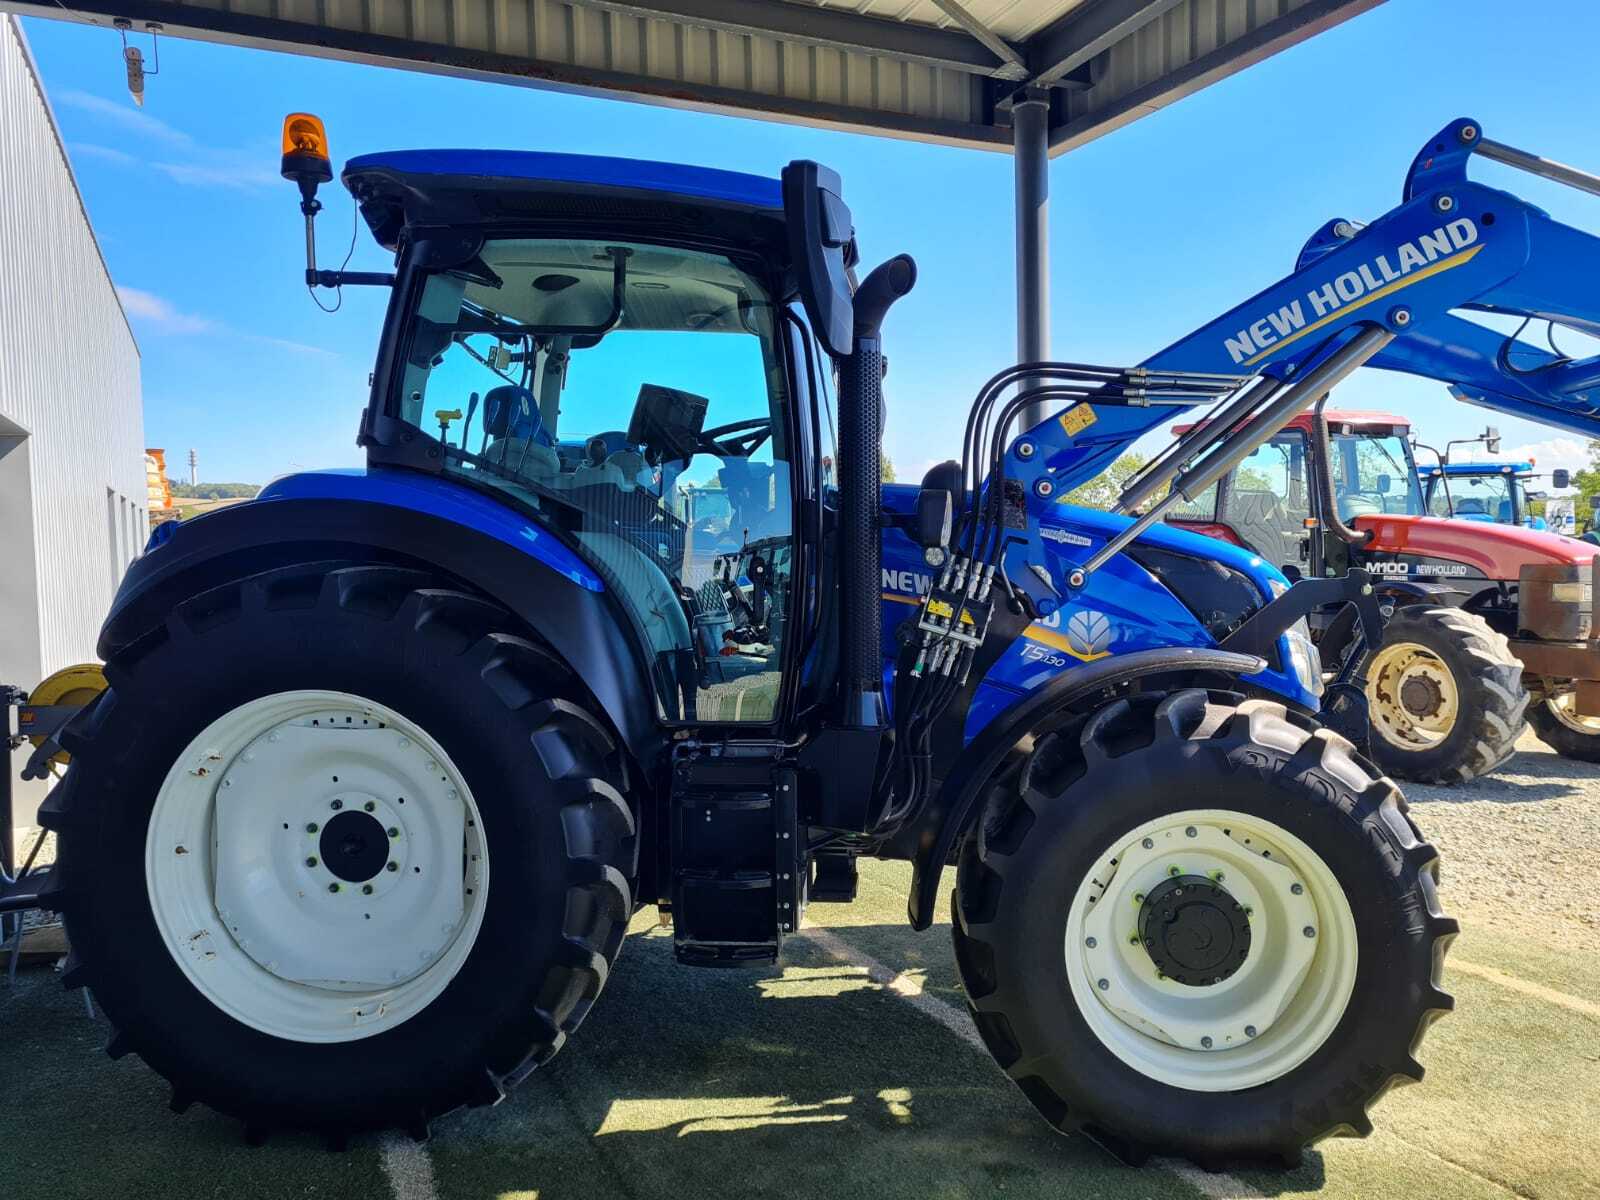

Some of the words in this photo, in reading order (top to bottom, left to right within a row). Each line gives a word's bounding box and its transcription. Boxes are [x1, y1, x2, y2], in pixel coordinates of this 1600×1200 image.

[1223, 299, 1306, 364] NEW
[1307, 217, 1478, 318] HOLLAND
[882, 568, 933, 594] NEW
[1366, 562, 1409, 574] M100
[1416, 565, 1433, 574] NEW
[1433, 565, 1467, 575] HOLLAND
